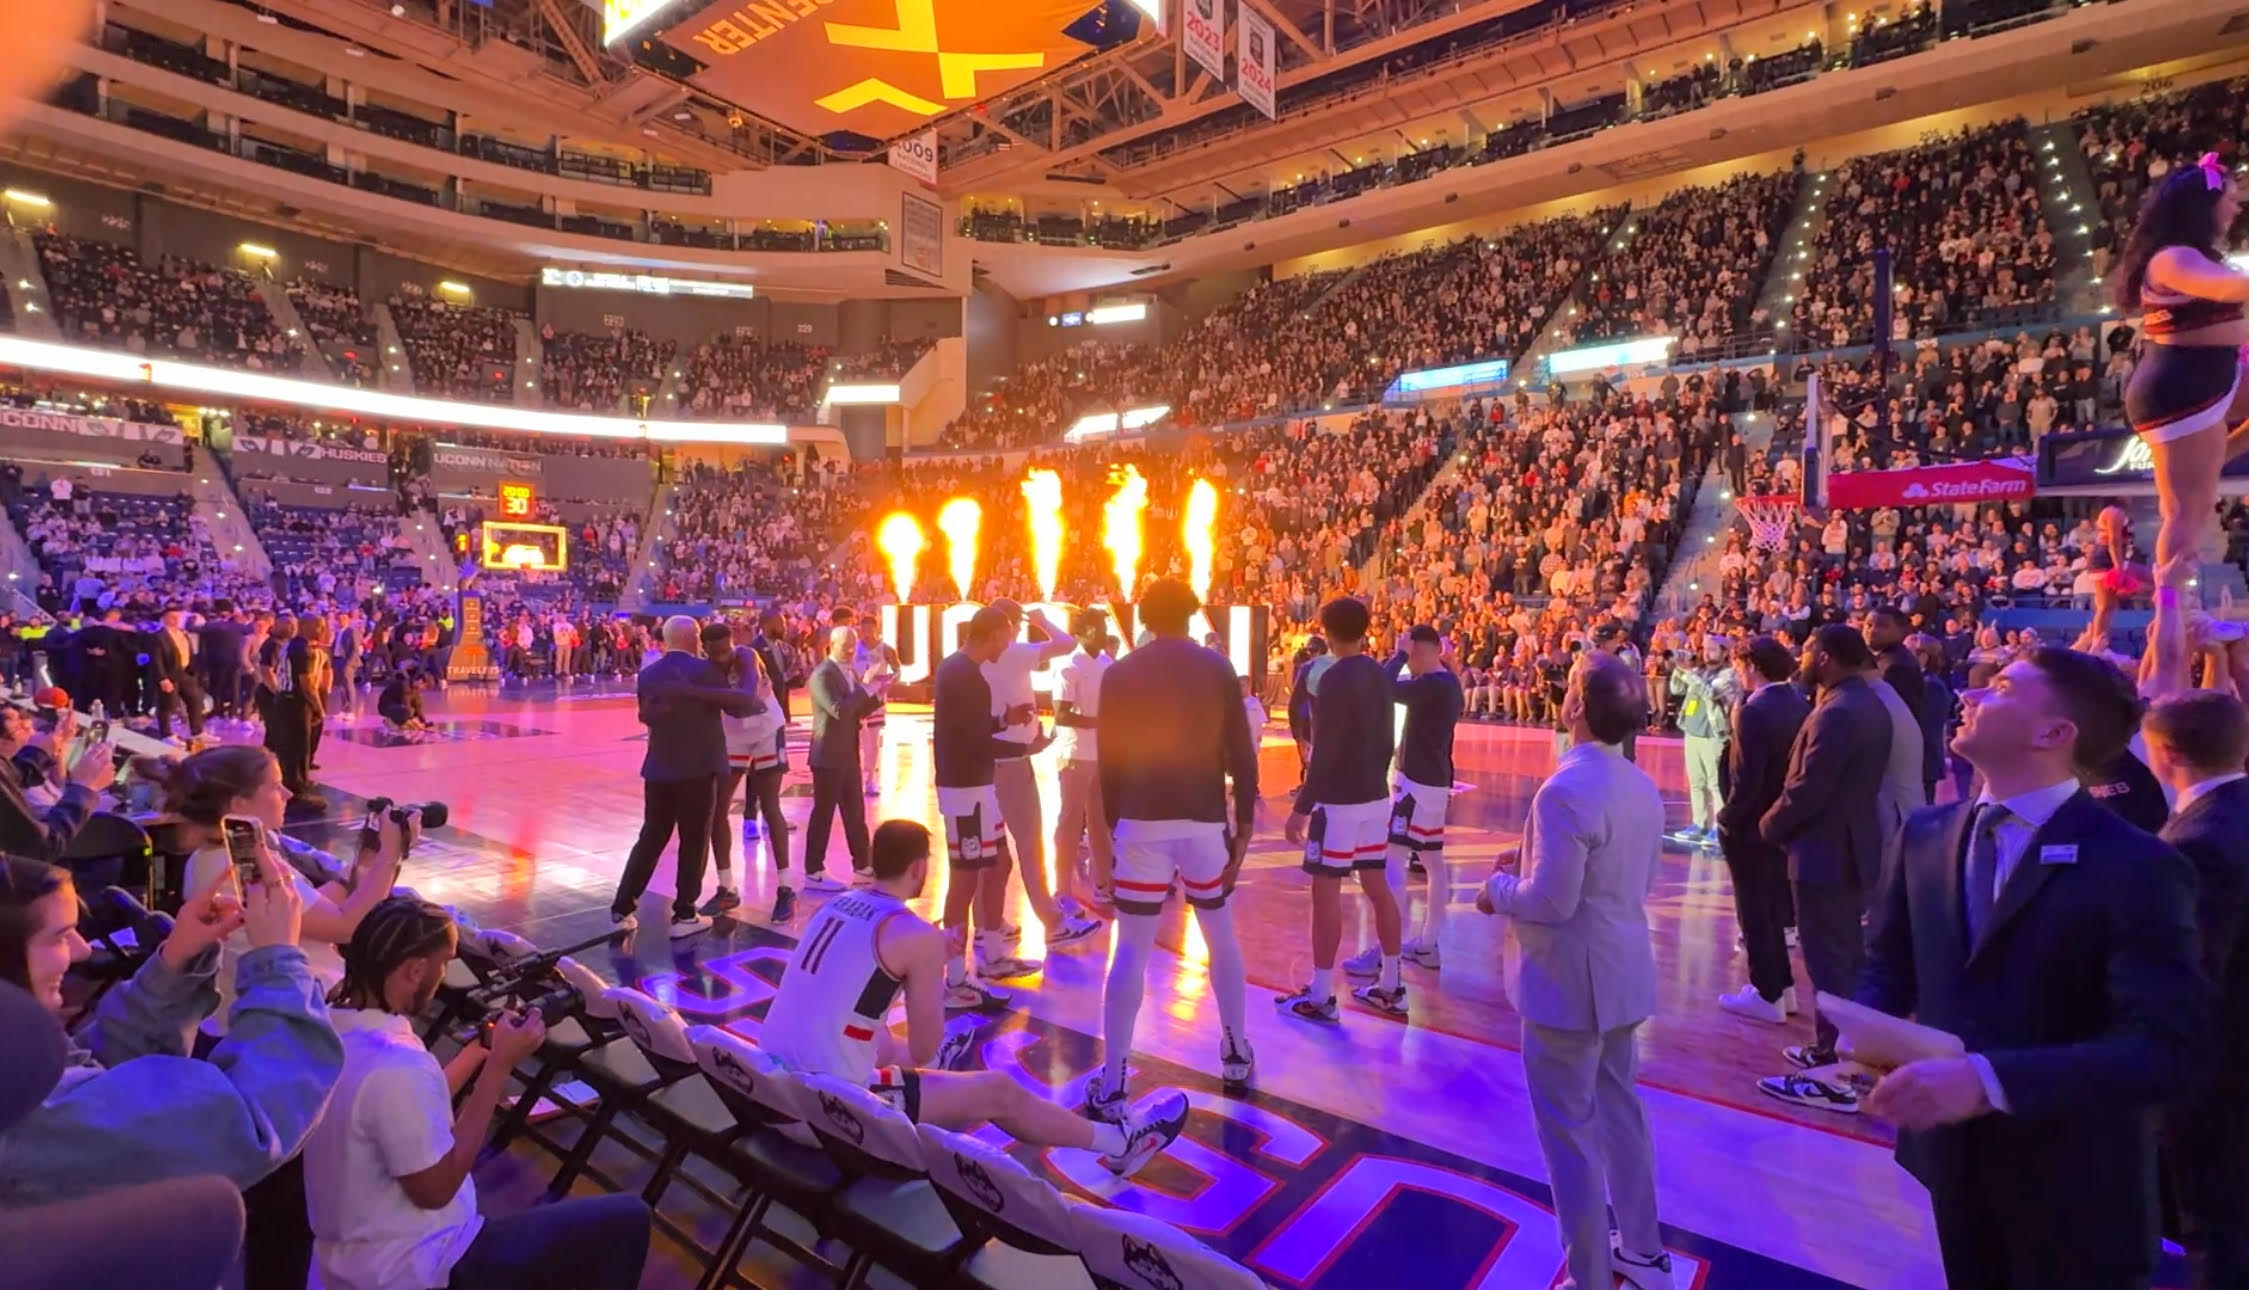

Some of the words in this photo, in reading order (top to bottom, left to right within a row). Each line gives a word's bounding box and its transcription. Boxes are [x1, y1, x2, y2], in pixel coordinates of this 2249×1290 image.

[1187, 11, 1220, 52] 2023
[1241, 58, 1272, 93] 2024
[896, 140, 933, 162] 009
[0, 411, 77, 433] CONN
[319, 447, 387, 463] HUSKIES
[433, 453, 486, 468] UCONN
[503, 486, 530, 498] 20:00
[506, 498, 528, 514] 30
[800, 917, 846, 975] 11
